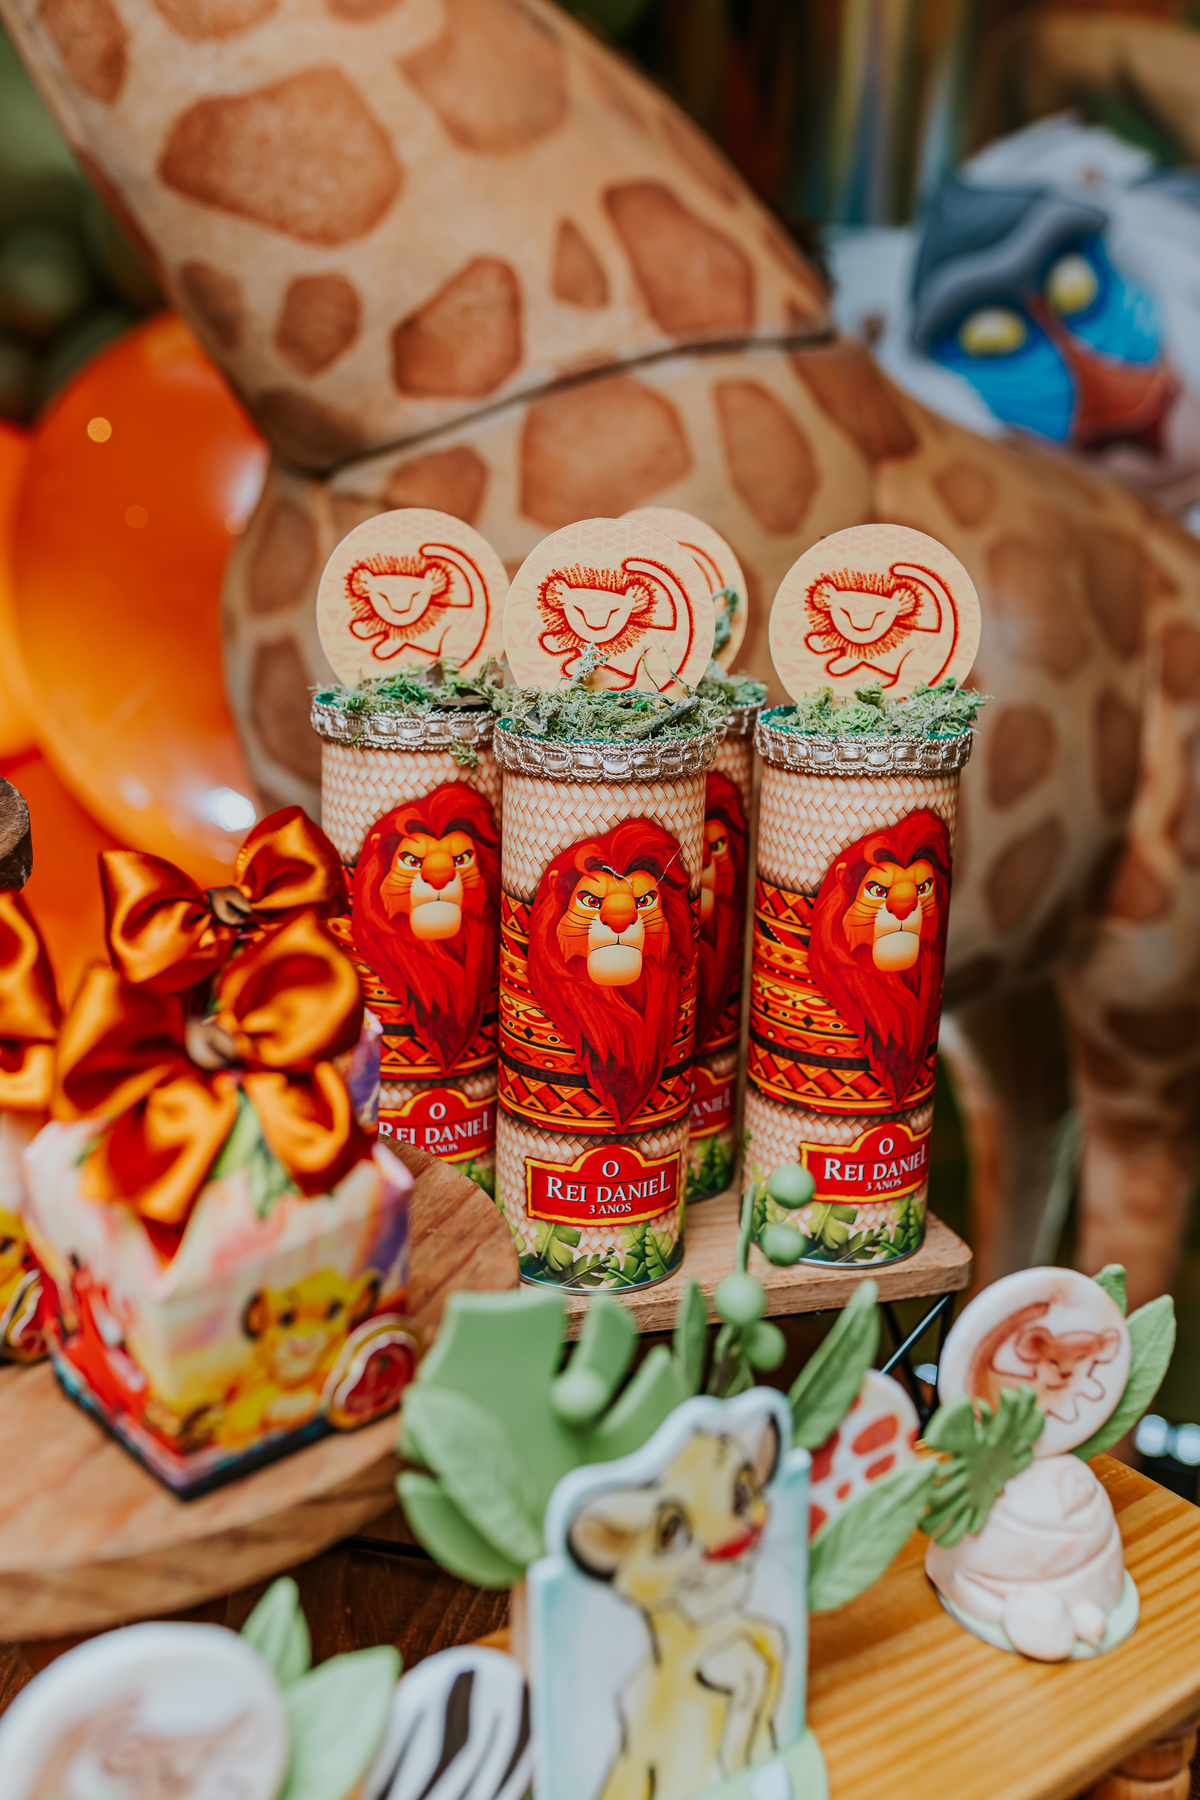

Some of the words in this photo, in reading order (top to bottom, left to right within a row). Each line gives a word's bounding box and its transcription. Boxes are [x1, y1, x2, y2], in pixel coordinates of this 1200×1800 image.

[429, 1102, 447, 1120] O
[379, 1121, 416, 1145] REI
[425, 1111, 493, 1144] DANIEL
[879, 1137, 895, 1155] O
[602, 1160, 620, 1178] O
[824, 1157, 865, 1182] REI
[872, 1143, 928, 1181] DANIEL
[546, 1175, 588, 1203] REI
[596, 1170, 672, 1203] DANIEL
[865, 1182, 873, 1192] 3
[873, 1178, 902, 1191] ANOS
[589, 1204, 597, 1215] 3
[598, 1203, 632, 1215] ANOS
